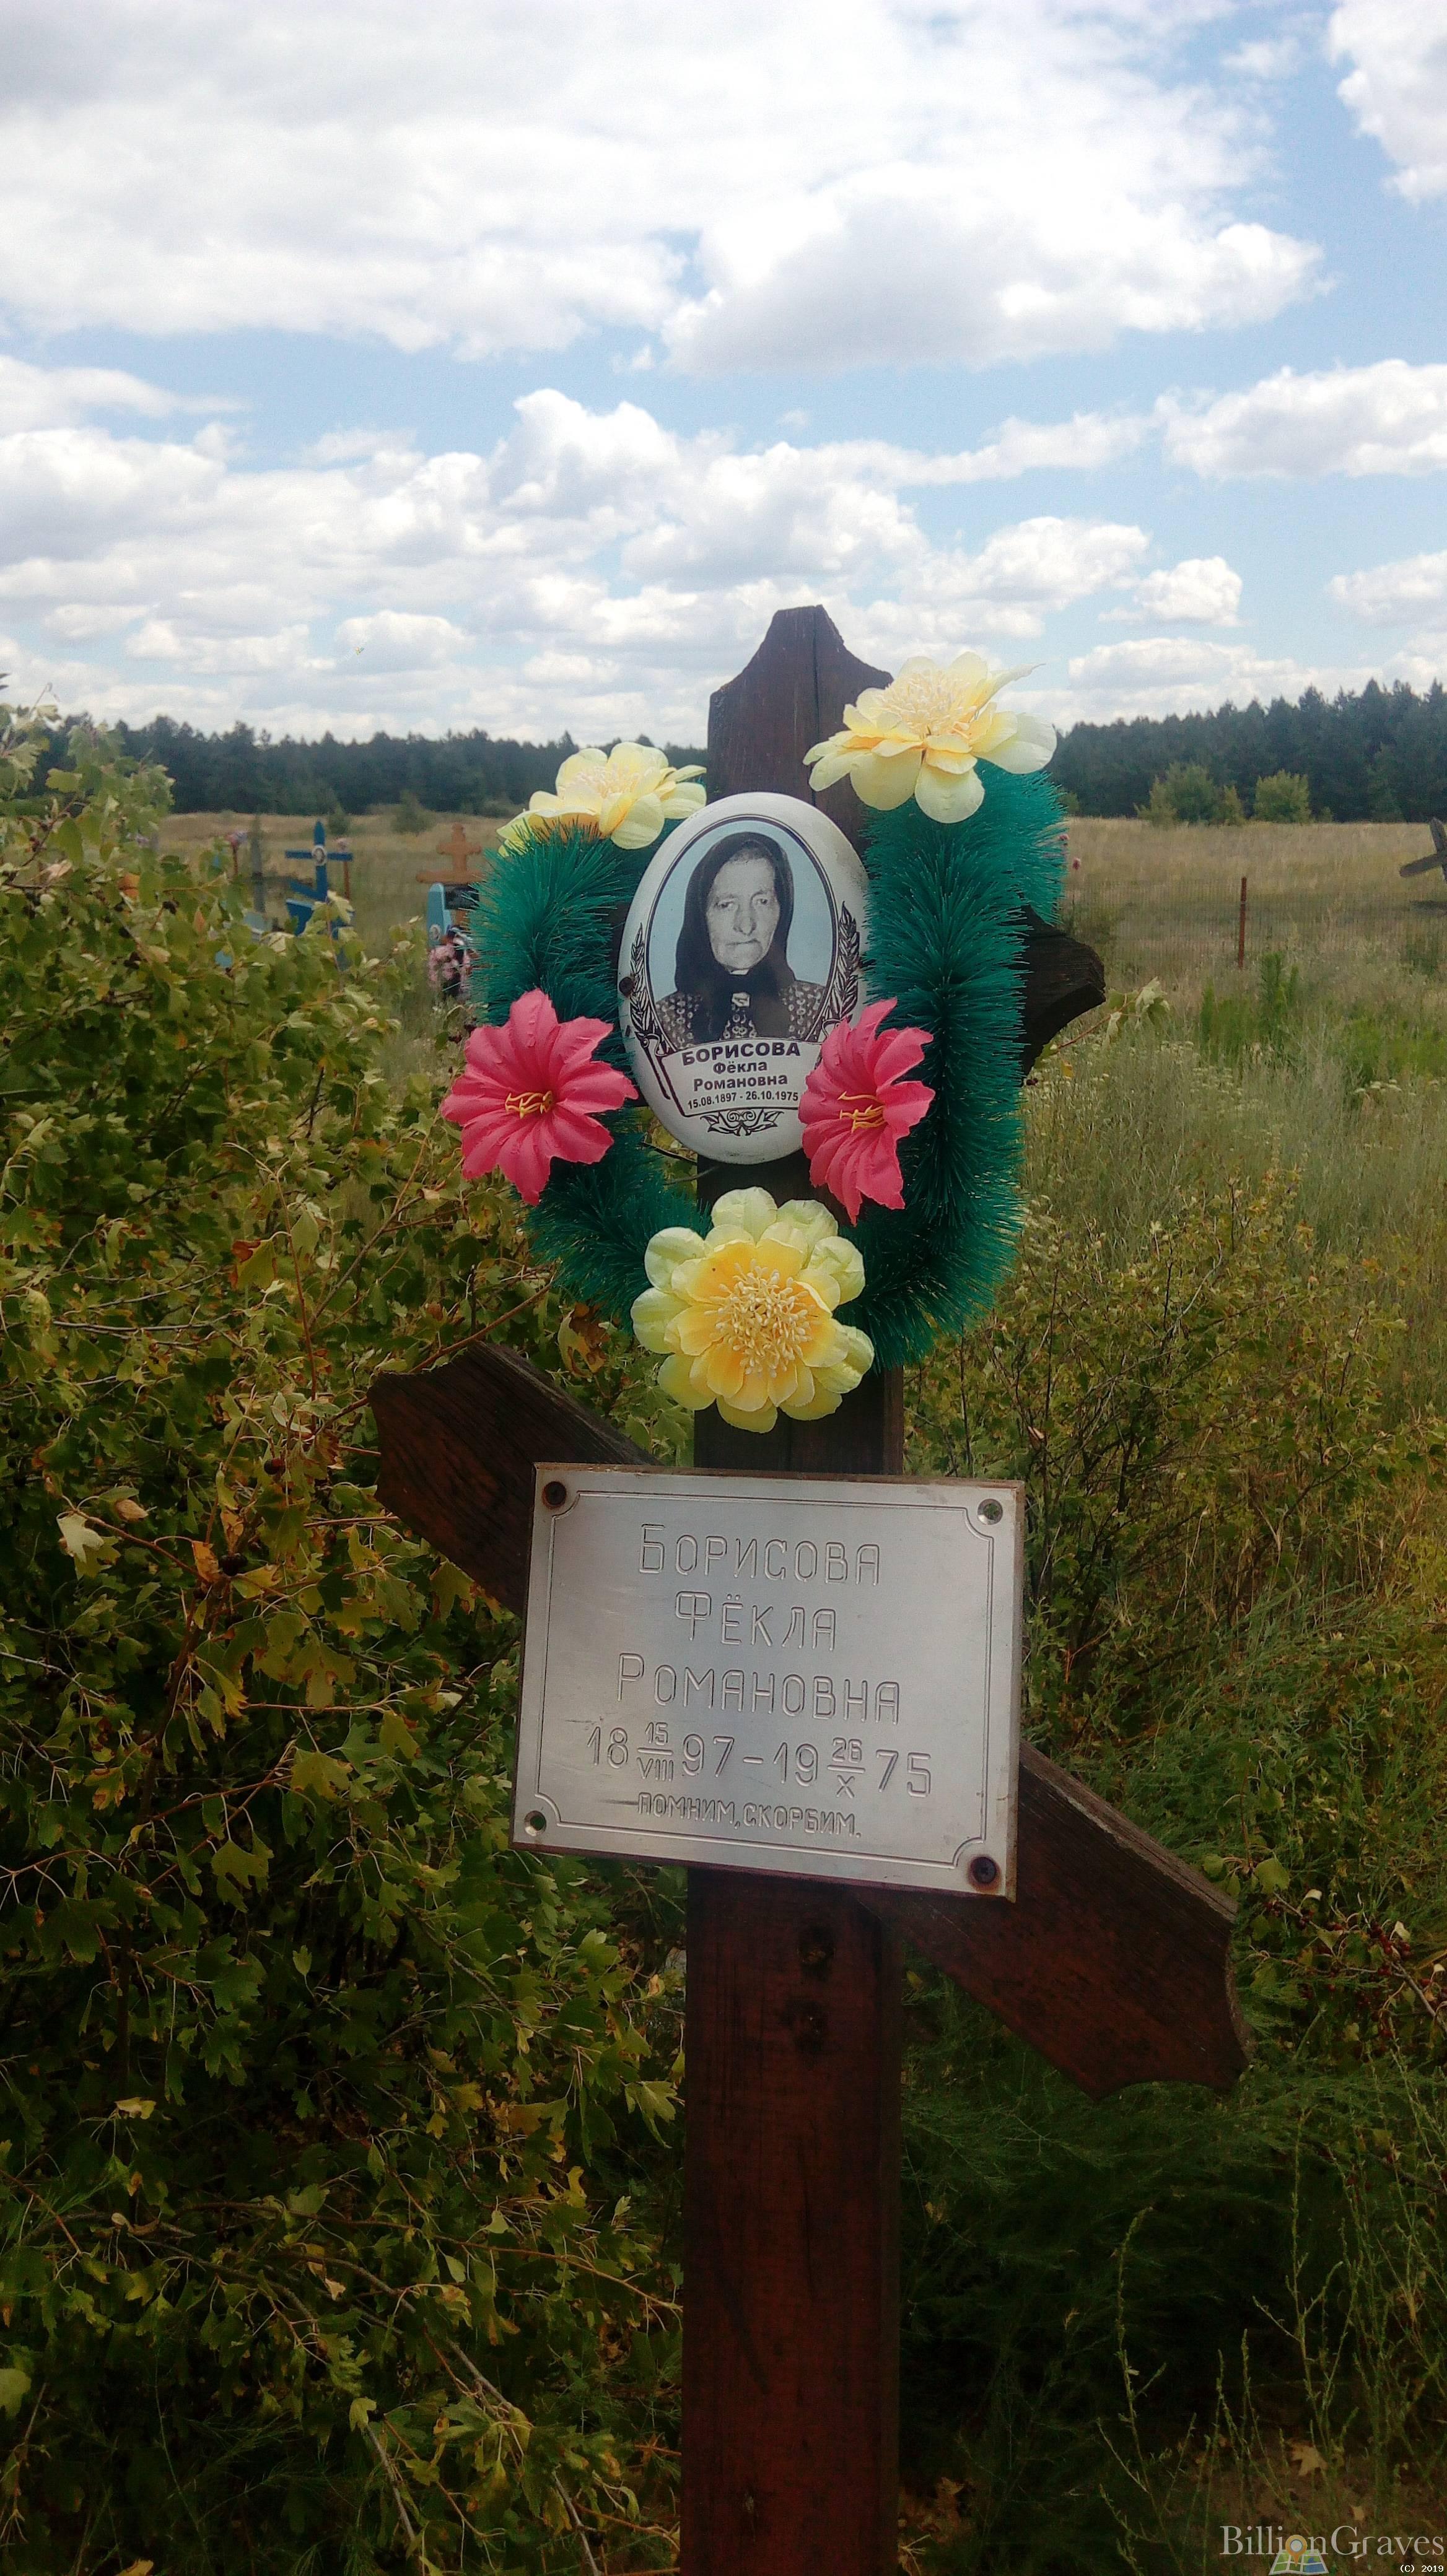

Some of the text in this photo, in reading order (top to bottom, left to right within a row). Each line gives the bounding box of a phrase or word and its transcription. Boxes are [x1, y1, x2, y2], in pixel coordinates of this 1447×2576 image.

[682, 1042, 801, 1066] БОРИСОВА
[713, 1060, 767, 1074] Фёкла
[693, 1074, 788, 1092] Романовна
[688, 1094, 737, 1110] 15.08.1897
[746, 1090, 798, 1102] 26.10.1975
[638, 1523, 881, 1586] БОРИСОВА
[674, 1590, 837, 1652] ФЁКЛА
[616, 1652, 901, 1726] РОМАНОВНА
